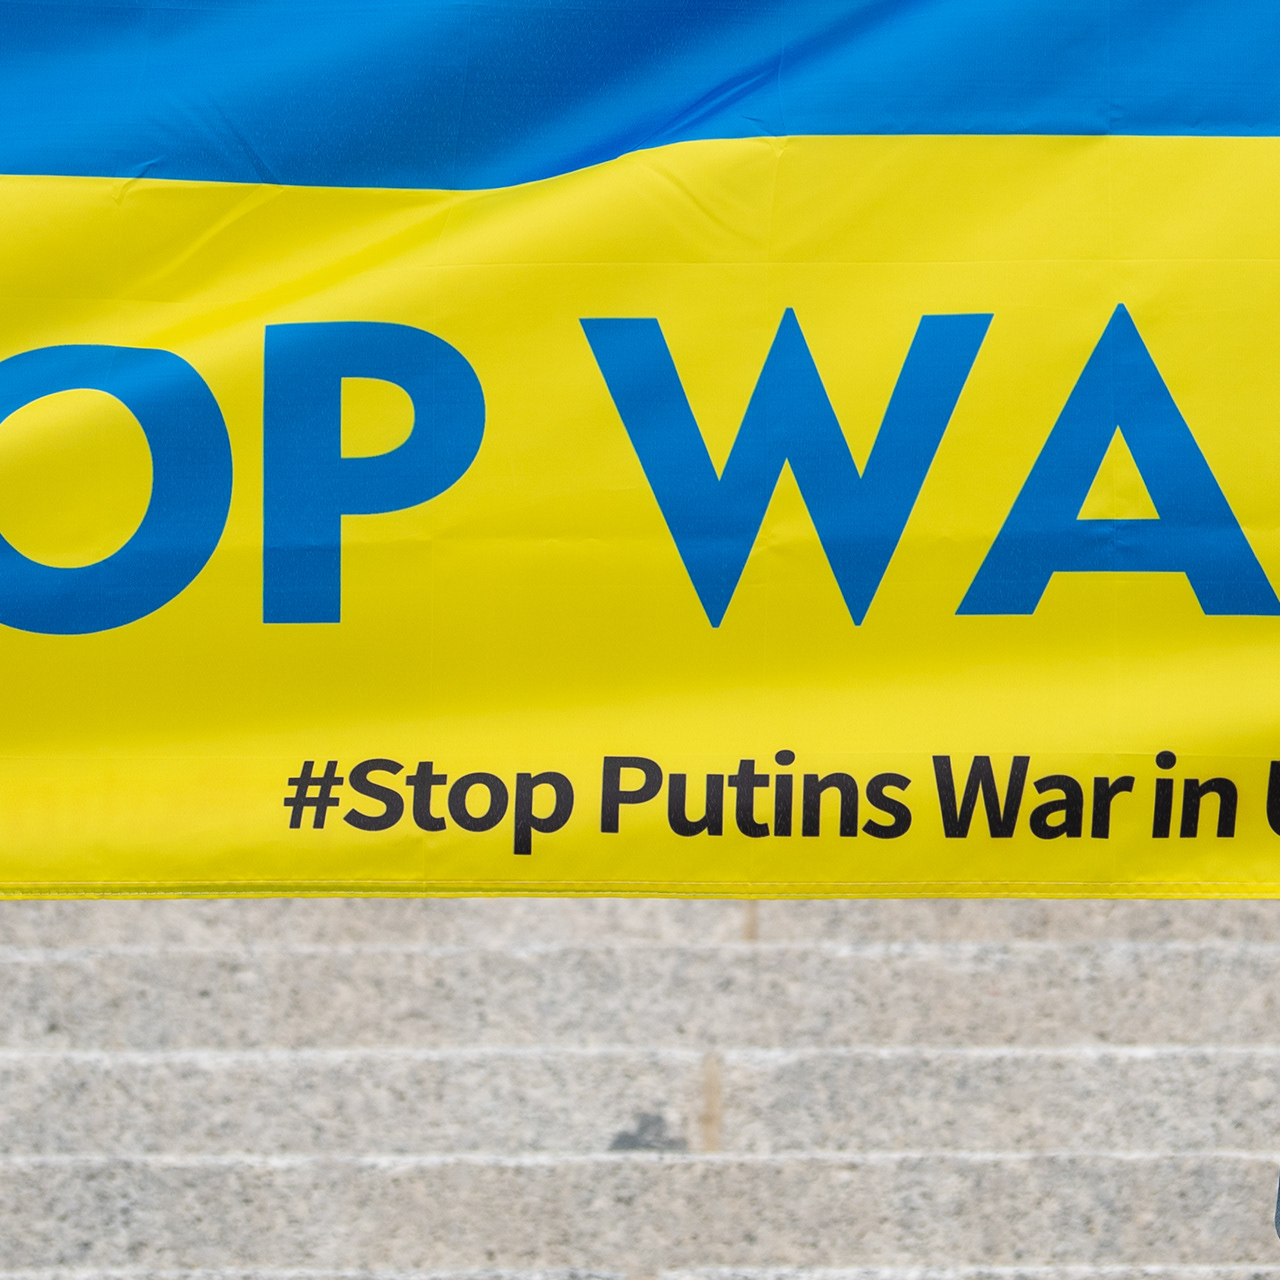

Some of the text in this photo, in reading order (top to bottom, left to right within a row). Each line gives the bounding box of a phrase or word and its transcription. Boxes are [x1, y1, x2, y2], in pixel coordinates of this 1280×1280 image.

[283, 757, 574, 856] #Stop
[600, 749, 912, 840] Putins
[932, 755, 1135, 840] War
[1151, 750, 1238, 839] in
